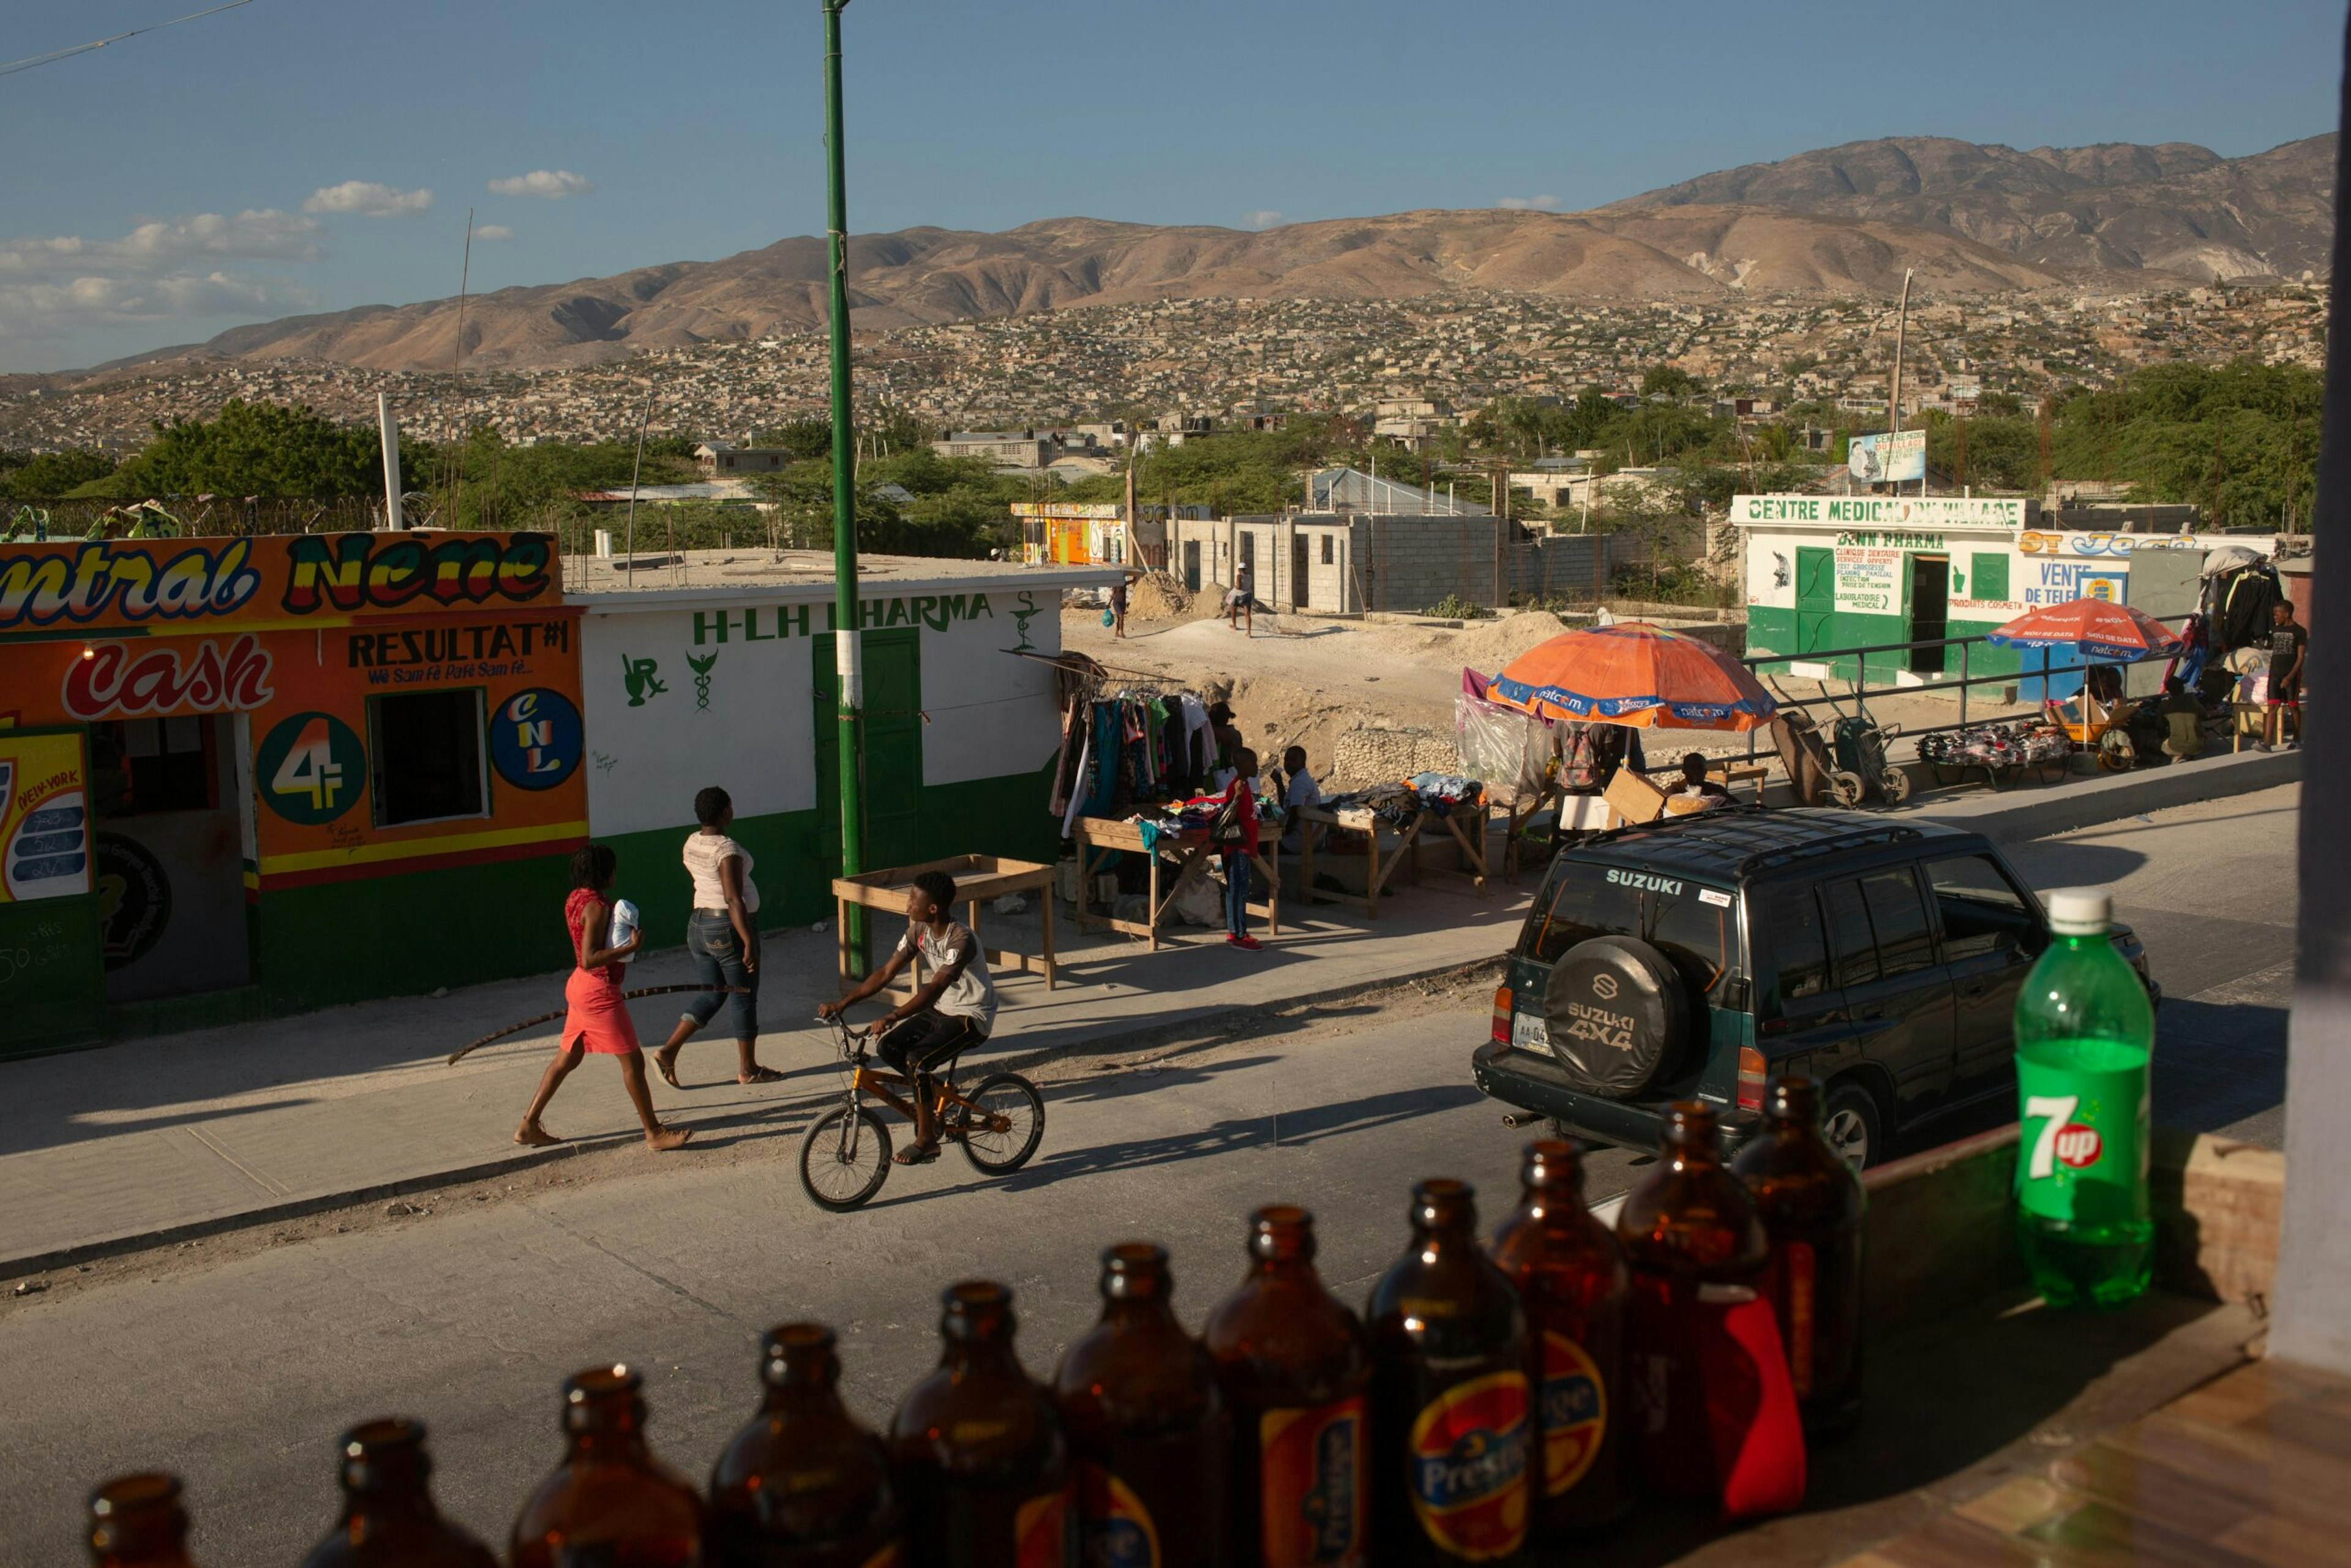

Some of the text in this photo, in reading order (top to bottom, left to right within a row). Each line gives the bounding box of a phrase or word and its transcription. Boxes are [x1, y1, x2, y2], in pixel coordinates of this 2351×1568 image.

[1889, 439, 1923, 449] ILLAGE
[1749, 499, 1819, 520] CENTRE
[1883, 532, 1943, 549] PHARMA
[2019, 531, 2063, 553] ST
[1835, 547, 1900, 558] CLINIQUE DENTAIRE
[2041, 563, 2091, 587] VENT
[1835, 593, 1880, 601] LABORATOIRE
[1949, 599, 1984, 609] PRODUITS
[2025, 588, 2041, 603] DE
[693, 605, 811, 645] H-LH
[348, 623, 543, 668] RESULTAT
[2087, 632, 2104, 640] NOU
[2117, 636, 2139, 645] DATA
[62, 631, 274, 720] Cash
[1606, 869, 1683, 896] SUZUKI
[1567, 1002, 1635, 1032] SUZUKI
[1567, 1019, 1633, 1052] 4X4
